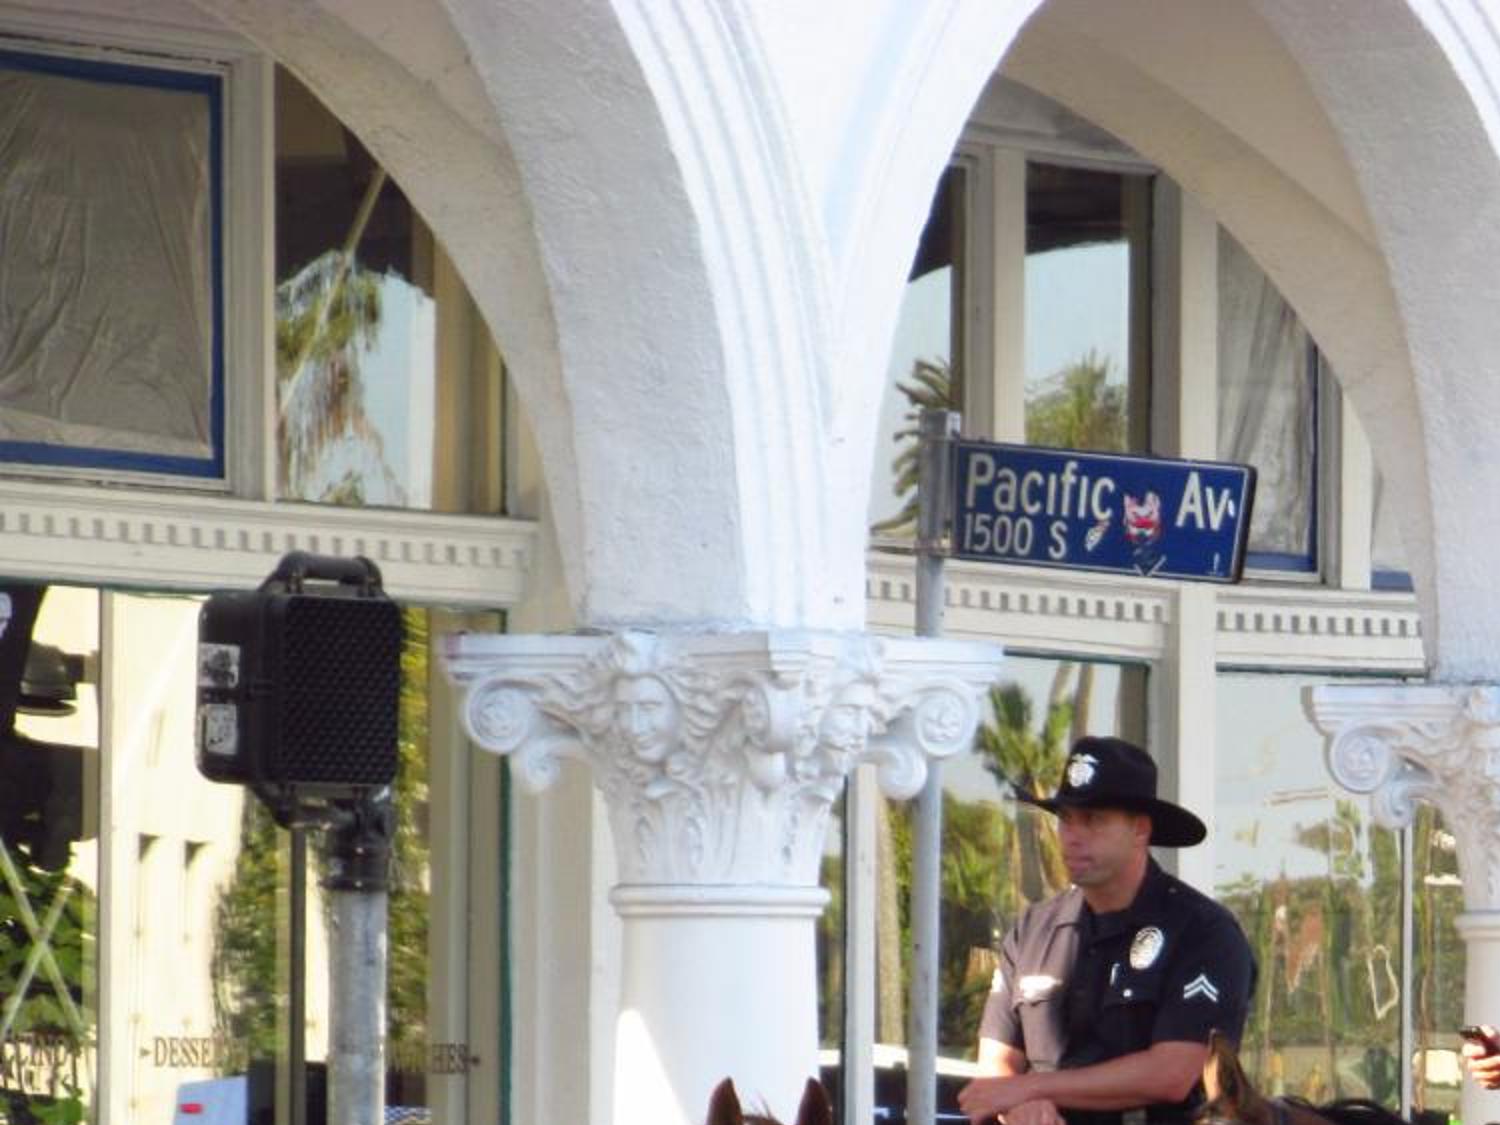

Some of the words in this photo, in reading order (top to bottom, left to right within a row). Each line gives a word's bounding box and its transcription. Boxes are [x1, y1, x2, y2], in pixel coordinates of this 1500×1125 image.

[965, 453, 1116, 521] Pacific
[963, 512, 1034, 556] 1500
[1048, 520, 1069, 560] S
